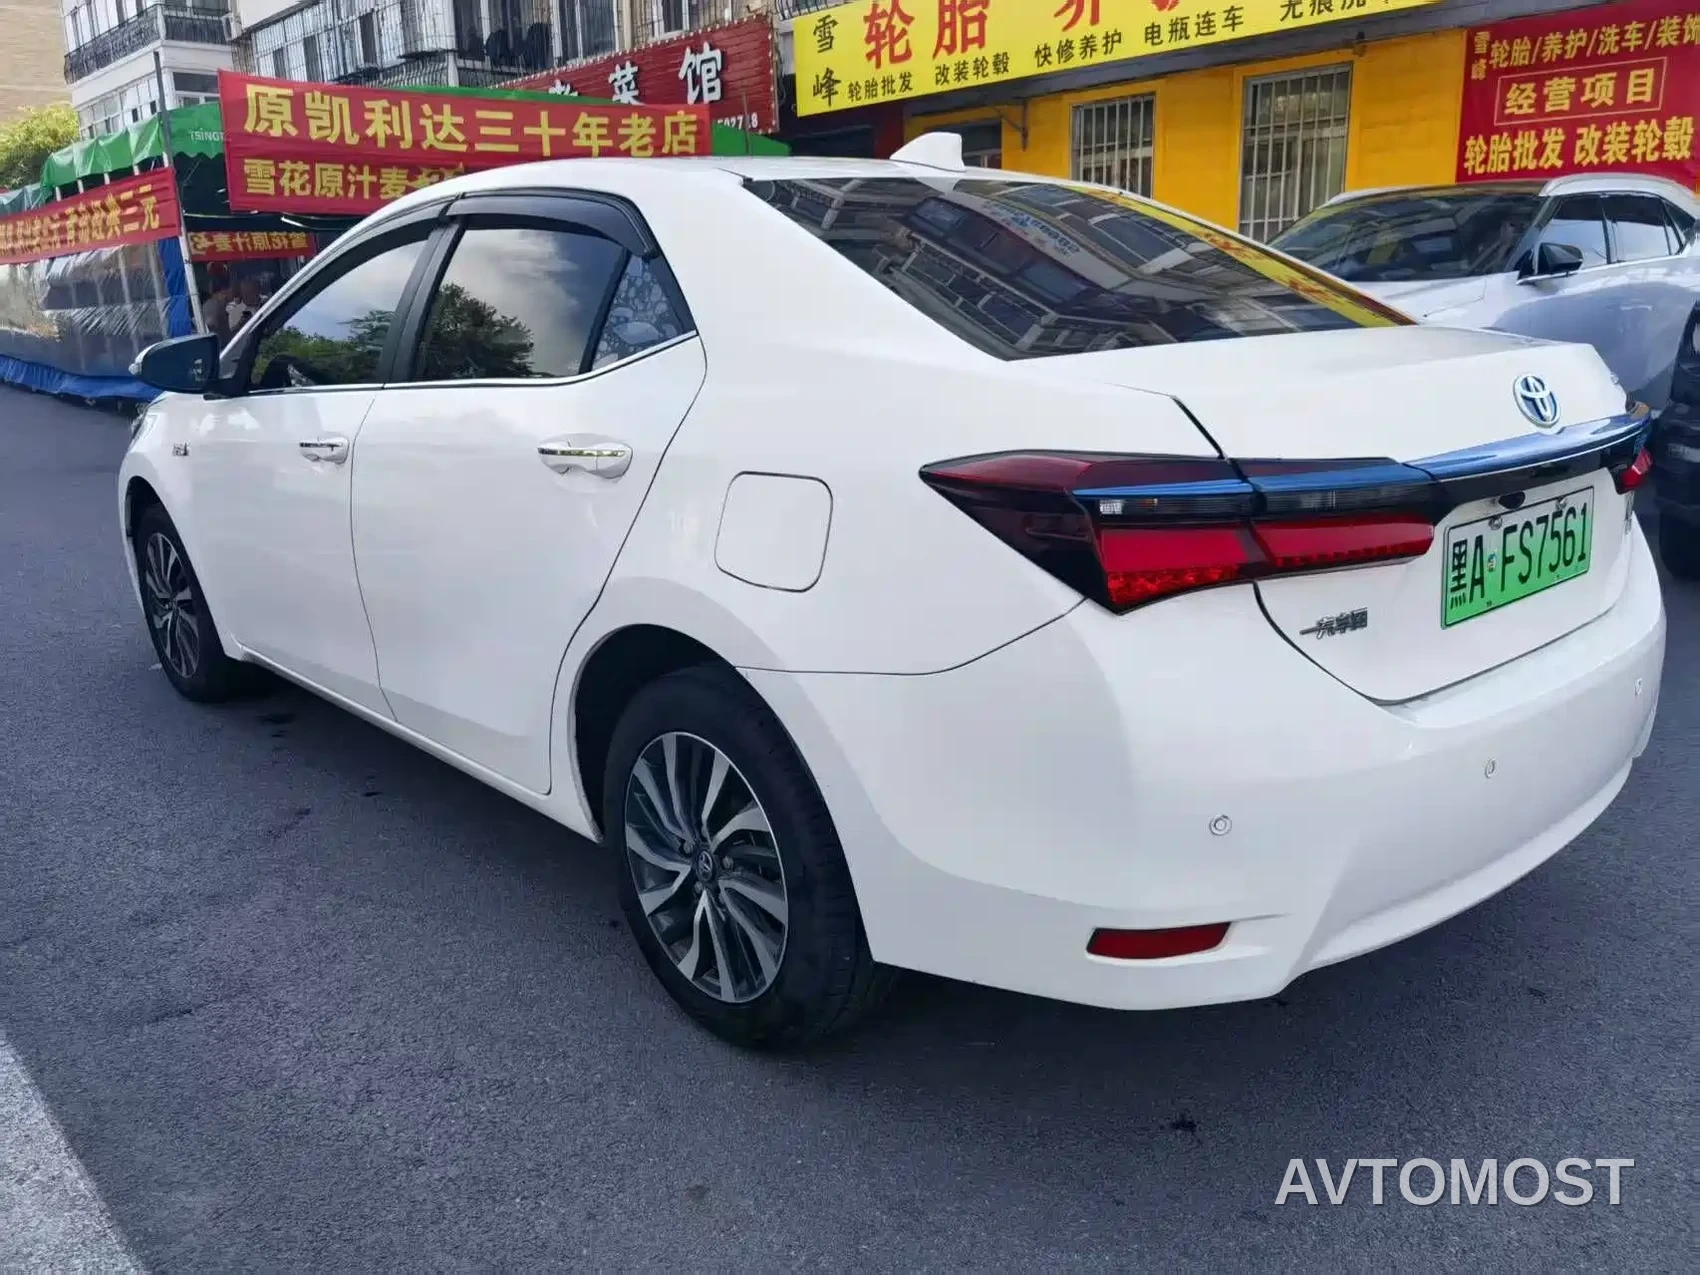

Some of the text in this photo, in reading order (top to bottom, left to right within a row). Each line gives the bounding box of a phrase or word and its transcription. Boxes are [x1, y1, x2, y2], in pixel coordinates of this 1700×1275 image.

[813, 14, 841, 108] 雪峰
[847, 71, 914, 103] 轮胎批发
[935, 51, 1010, 86] 改装轮毂
[1034, 28, 1122, 67] 快修养护
[1144, 5, 1244, 46] 电瓶连车
[1471, 31, 1491, 80] 雪峰
[244, 84, 698, 158] 原凯利达三十年老店
[1504, 68, 1655, 115] 经营项目
[1464, 116, 1694, 175] 轮胎批发 改装轮毂
[1450, 535, 1486, 609] 黑A
[1500, 502, 1588, 592] FS7561
